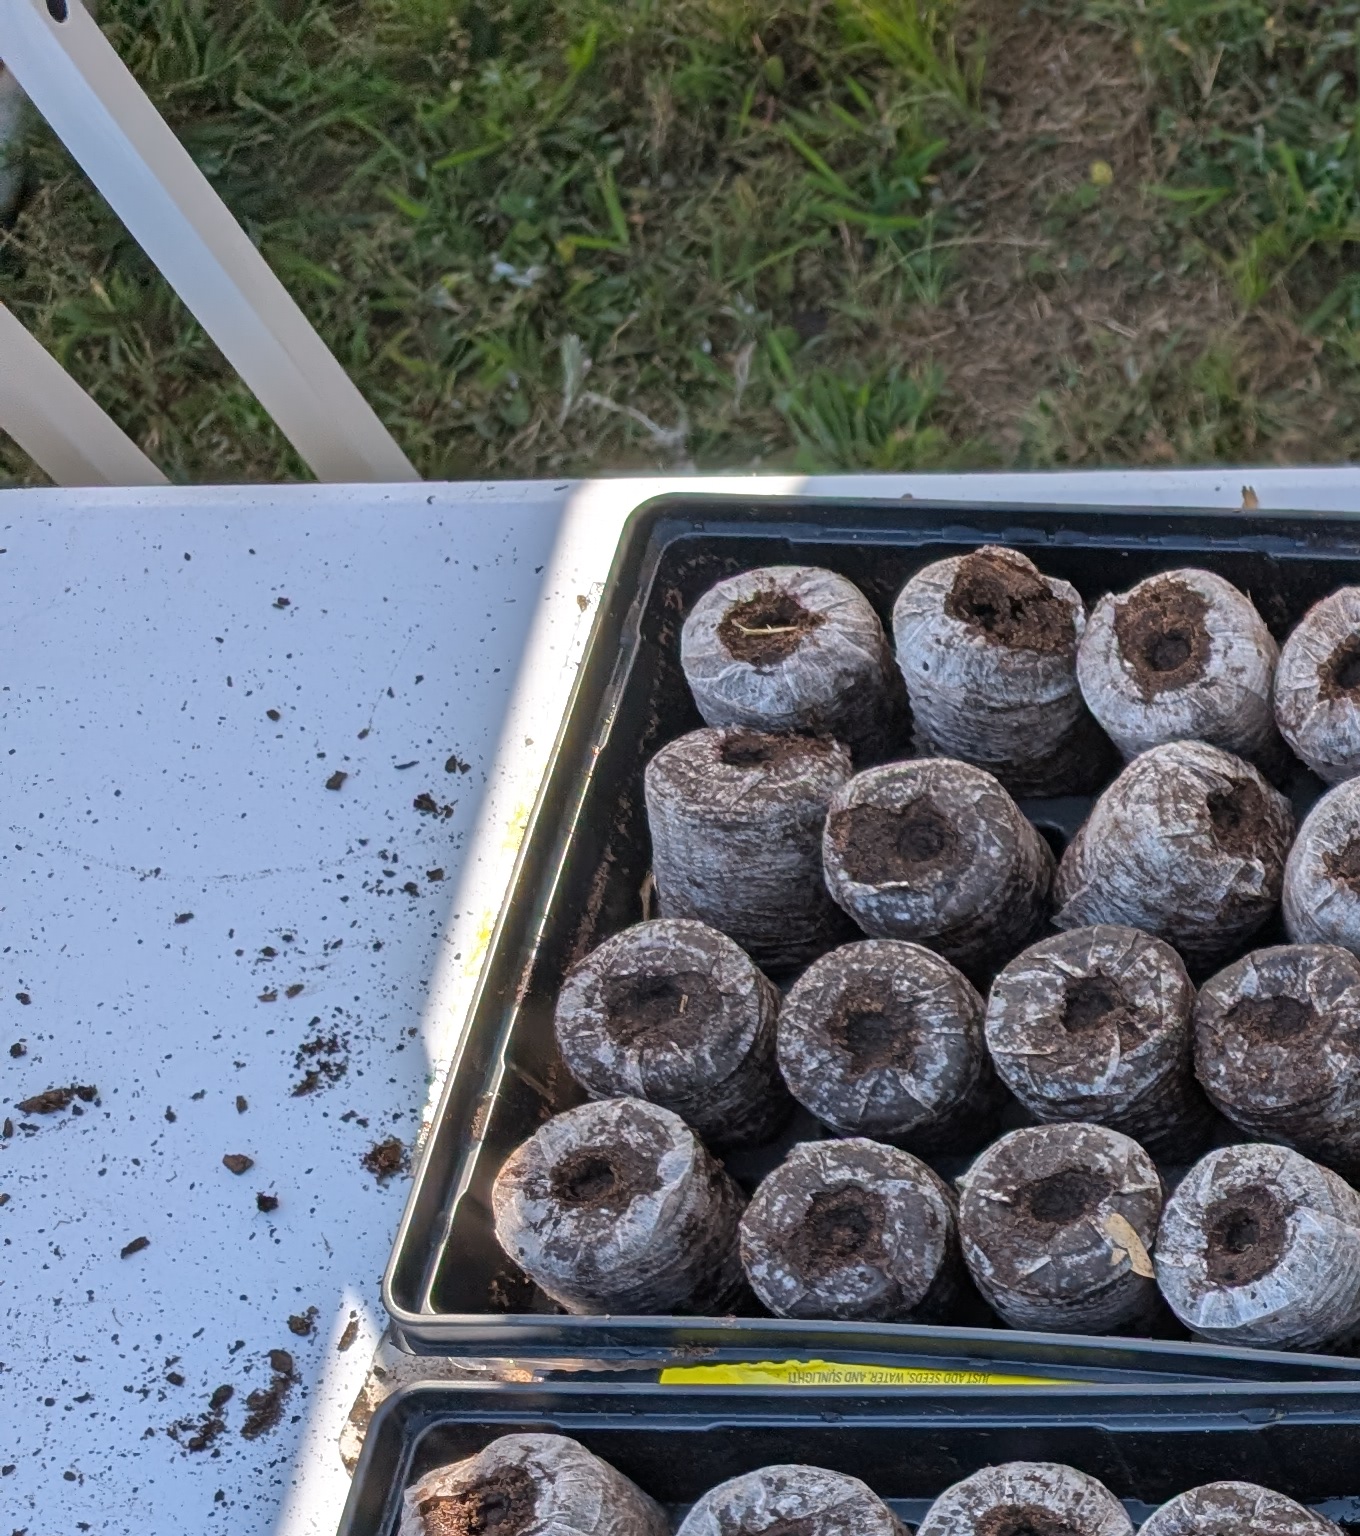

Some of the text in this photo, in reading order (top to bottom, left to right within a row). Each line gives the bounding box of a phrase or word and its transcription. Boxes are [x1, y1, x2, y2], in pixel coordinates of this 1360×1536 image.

[844, 1371, 865, 1384] AND
[944, 1372, 965, 1384] ADD
[966, 1372, 993, 1384] JUST
